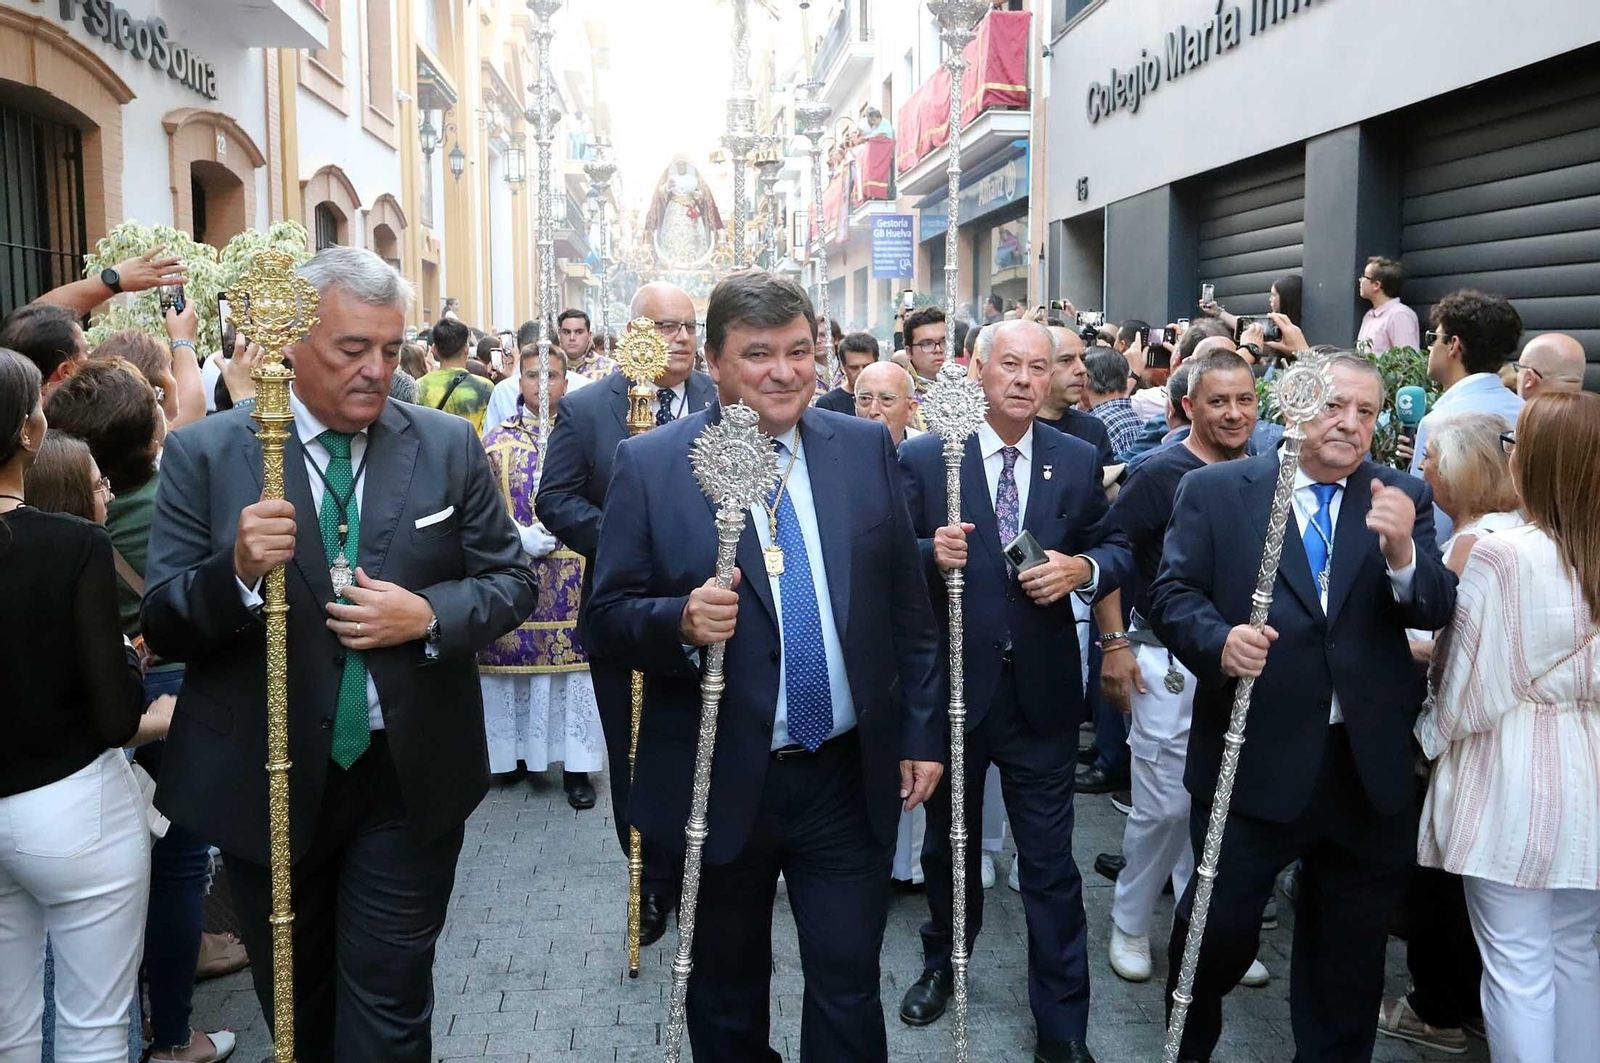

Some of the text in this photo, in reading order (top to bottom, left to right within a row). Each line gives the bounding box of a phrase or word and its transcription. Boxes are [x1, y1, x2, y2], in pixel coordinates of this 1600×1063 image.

[1086, 49, 1160, 124] Colegio
[1165, 0, 1241, 82] María
[1075, 176, 1089, 201] 15
[877, 218, 908, 228] Gestoría
[886, 228, 912, 238] Huelva
